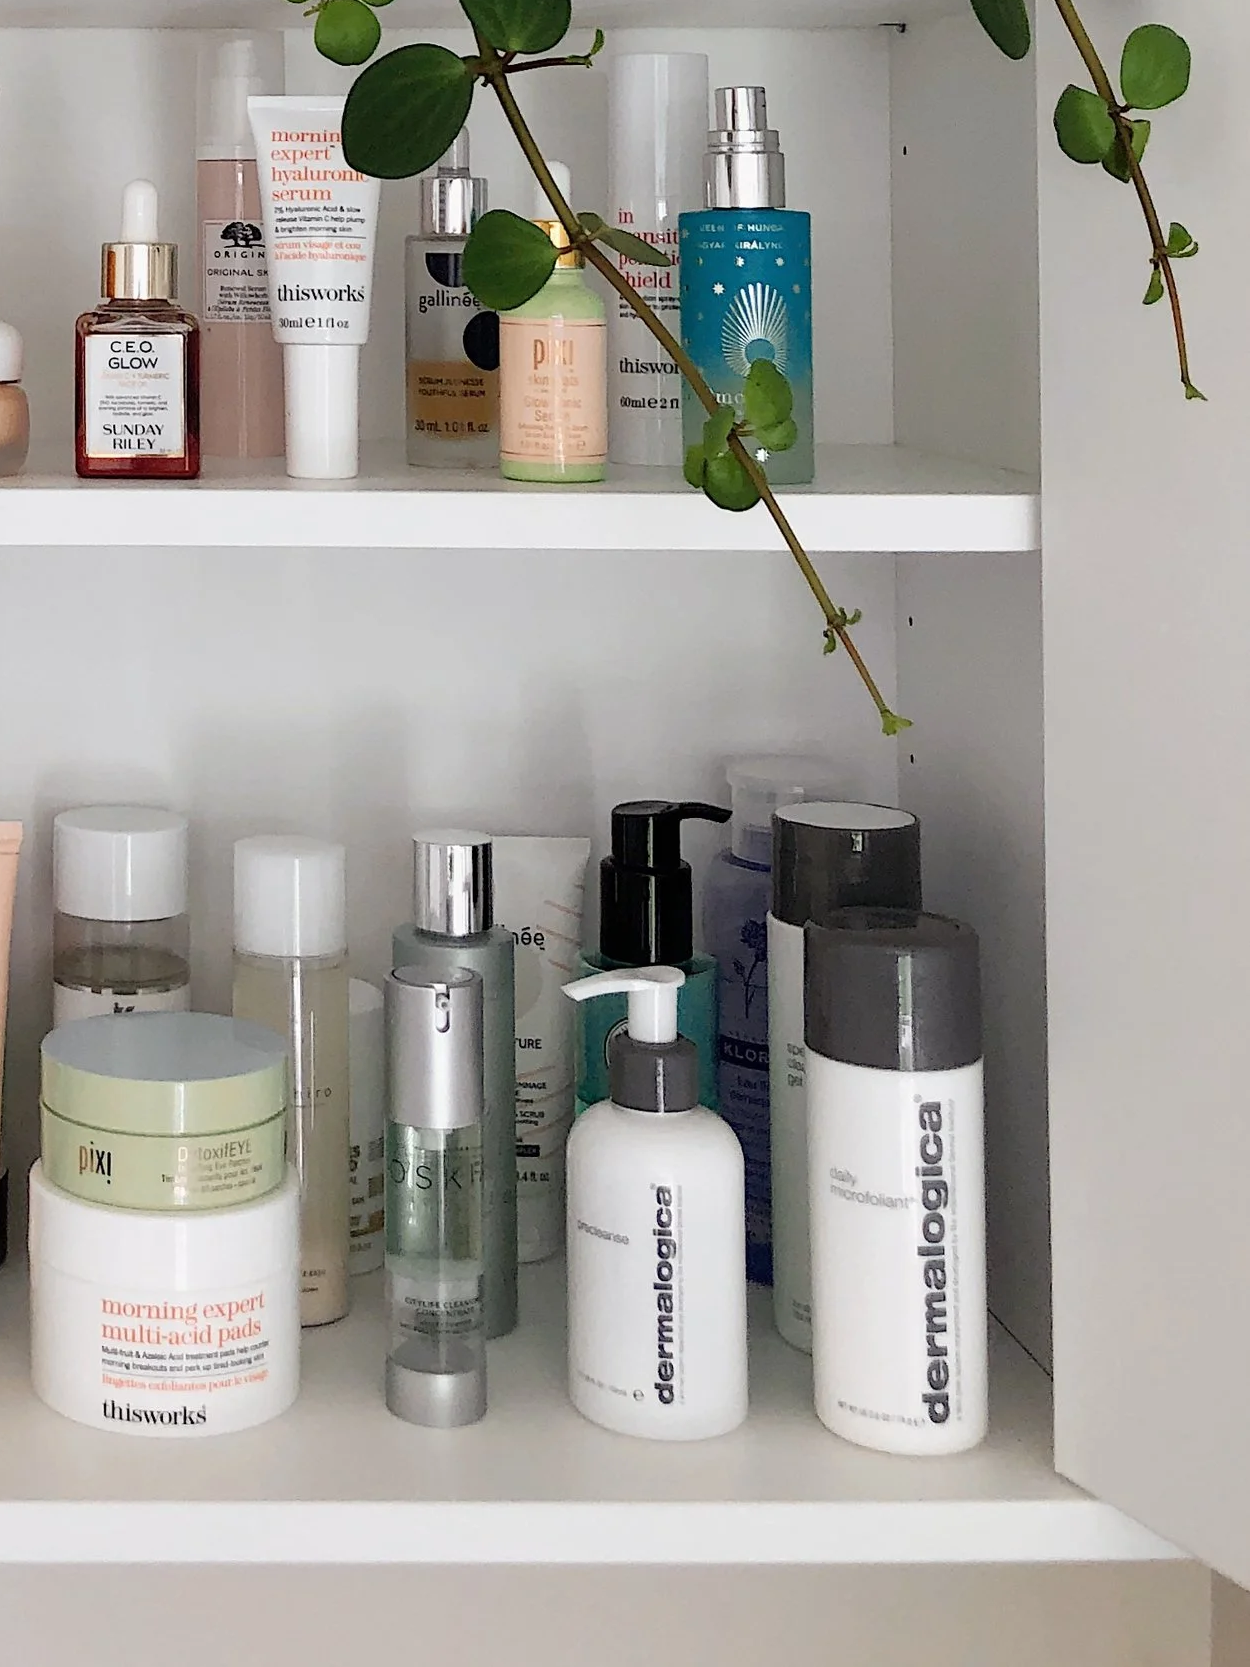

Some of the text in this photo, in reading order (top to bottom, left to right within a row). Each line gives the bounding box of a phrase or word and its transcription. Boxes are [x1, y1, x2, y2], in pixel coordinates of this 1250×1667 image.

[272, 130, 341, 142] mornin
[271, 148, 331, 164] expert
[272, 166, 369, 185] hyaluronic
[272, 188, 331, 201] serum
[286, 206, 320, 214] Hyaluronic
[618, 208, 634, 223] in
[110, 341, 155, 353] C.E.O.
[109, 357, 158, 369] GLOW
[103, 424, 164, 435] SUNDAY
[113, 438, 155, 450] RILEY
[516, 1038, 542, 1049] TURE
[724, 1042, 769, 1063] KLOR
[829, 1183, 910, 1211] microfoliant
[915, 1100, 950, 1424] dermalogica
[653, 1185, 677, 1405] dermalogica
[102, 1290, 265, 1325] morning expert
[102, 1318, 262, 1348] multi-acid pads
[186, 1351, 218, 1360] treatment
[102, 1358, 130, 1370] morning
[132, 1363, 167, 1371] breakouts
[208, 1379, 233, 1392] pour
